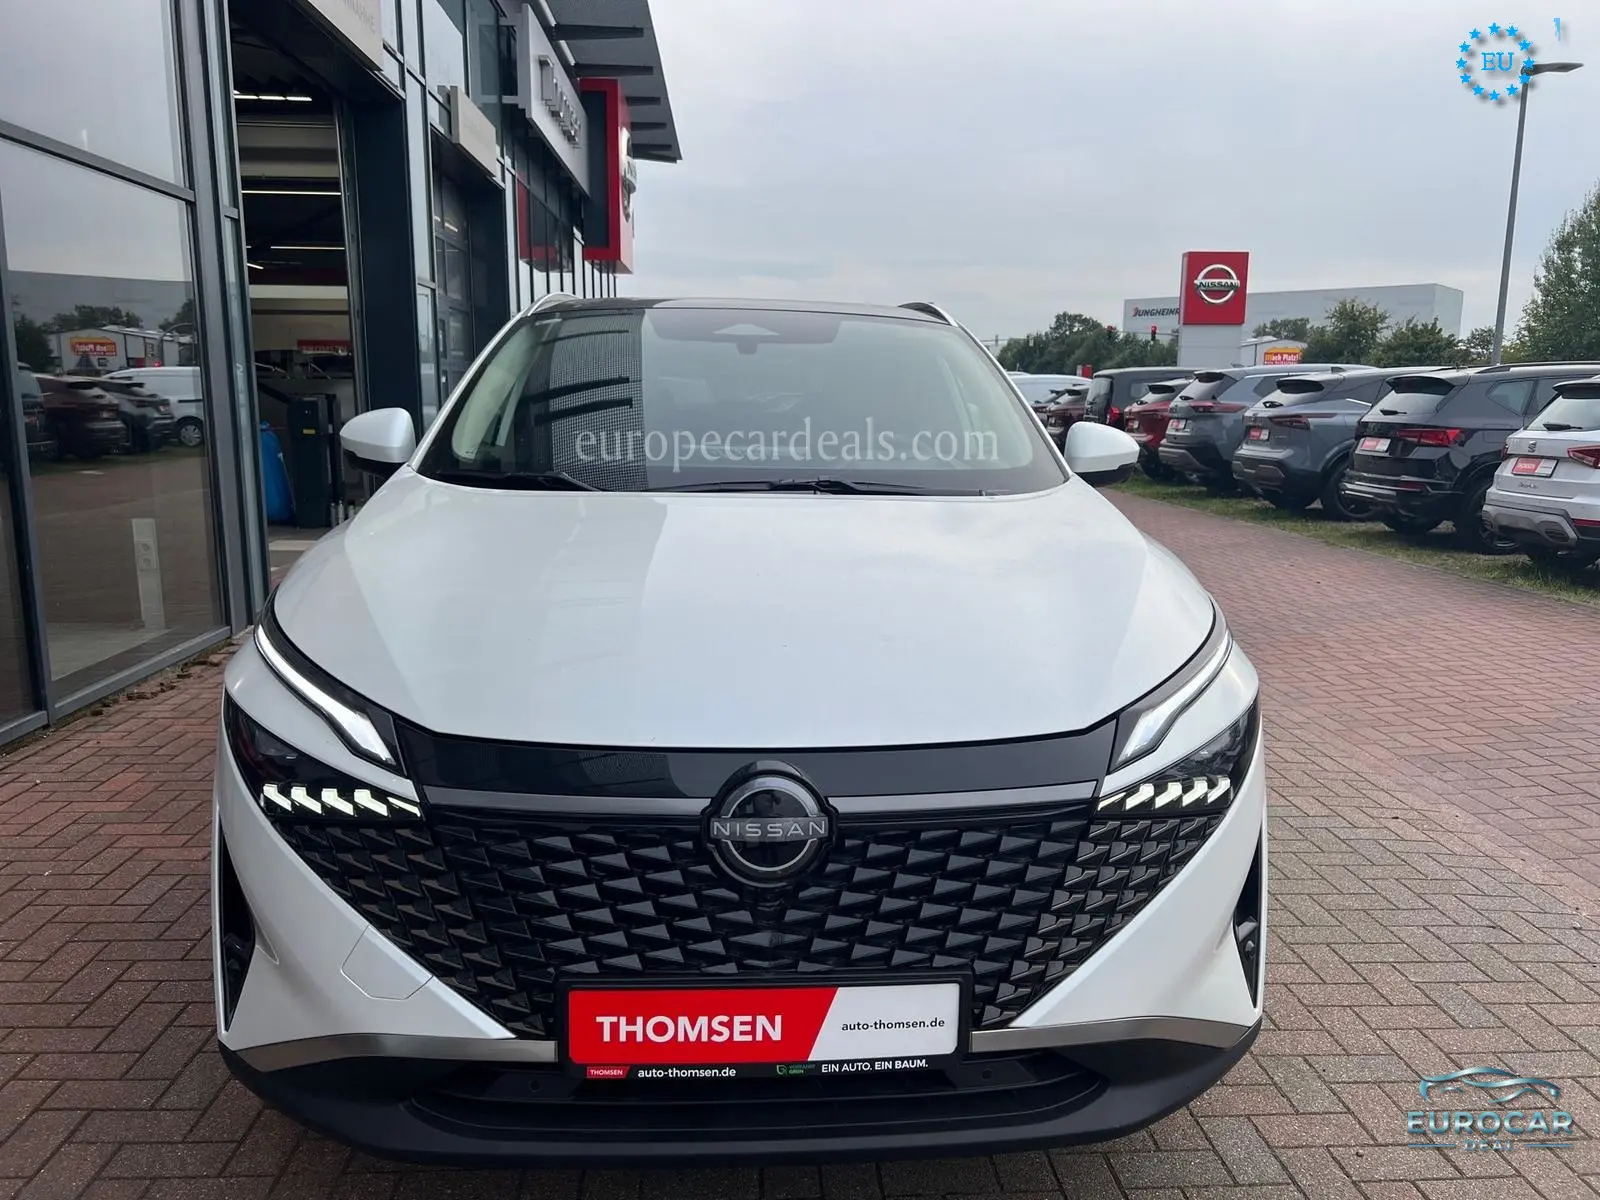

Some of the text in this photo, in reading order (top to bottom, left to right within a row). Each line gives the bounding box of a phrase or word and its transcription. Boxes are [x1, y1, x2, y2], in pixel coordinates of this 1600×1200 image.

[1199, 281, 1238, 289] NISSAN
[713, 821, 825, 837] NISSAN
[596, 1014, 782, 1043] THOMSEN
[841, 1017, 945, 1032] auto-thomsen.de
[590, 1068, 624, 1076] THOMSEN
[637, 1067, 736, 1078] auto-thomsen.de
[821, 1063, 839, 1073] EIN
[842, 1062, 873, 1072] AUTO.
[875, 1061, 892, 1070] EIN
[894, 1059, 928, 1069] BAUM.
